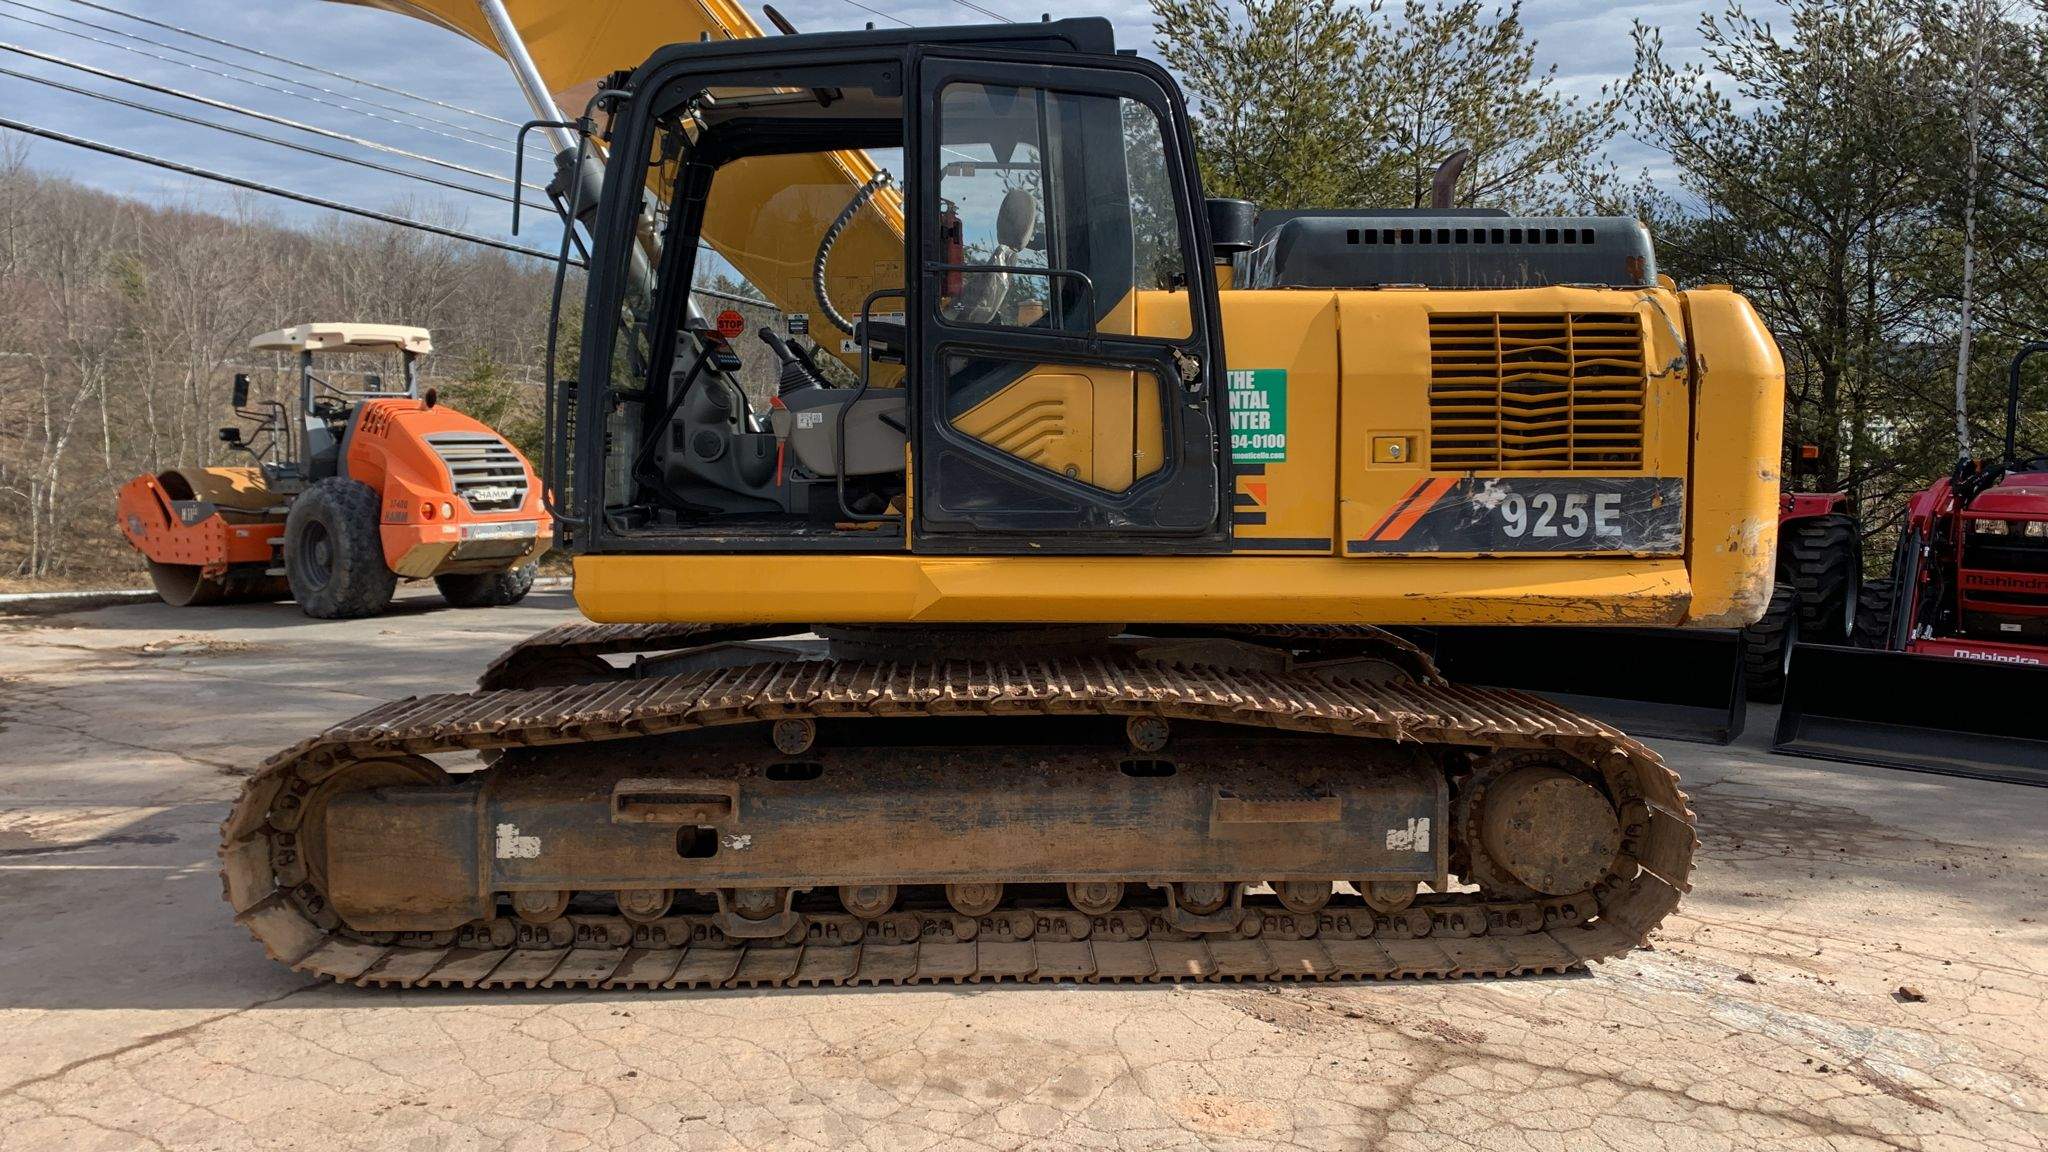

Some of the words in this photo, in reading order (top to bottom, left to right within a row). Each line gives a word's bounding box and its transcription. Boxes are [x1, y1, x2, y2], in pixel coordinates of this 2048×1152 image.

[718, 320, 742, 329] STOP
[1227, 371, 1255, 389] THE
[1229, 391, 1270, 409] NTAL
[1230, 412, 1271, 430] NTER
[1231, 434, 1285, 448] 94-0100
[480, 490, 508, 498] HAMM
[1501, 493, 1622, 538] 925E
[1966, 575, 2048, 588] Mahindr
[1953, 649, 2040, 664] Mahindra
